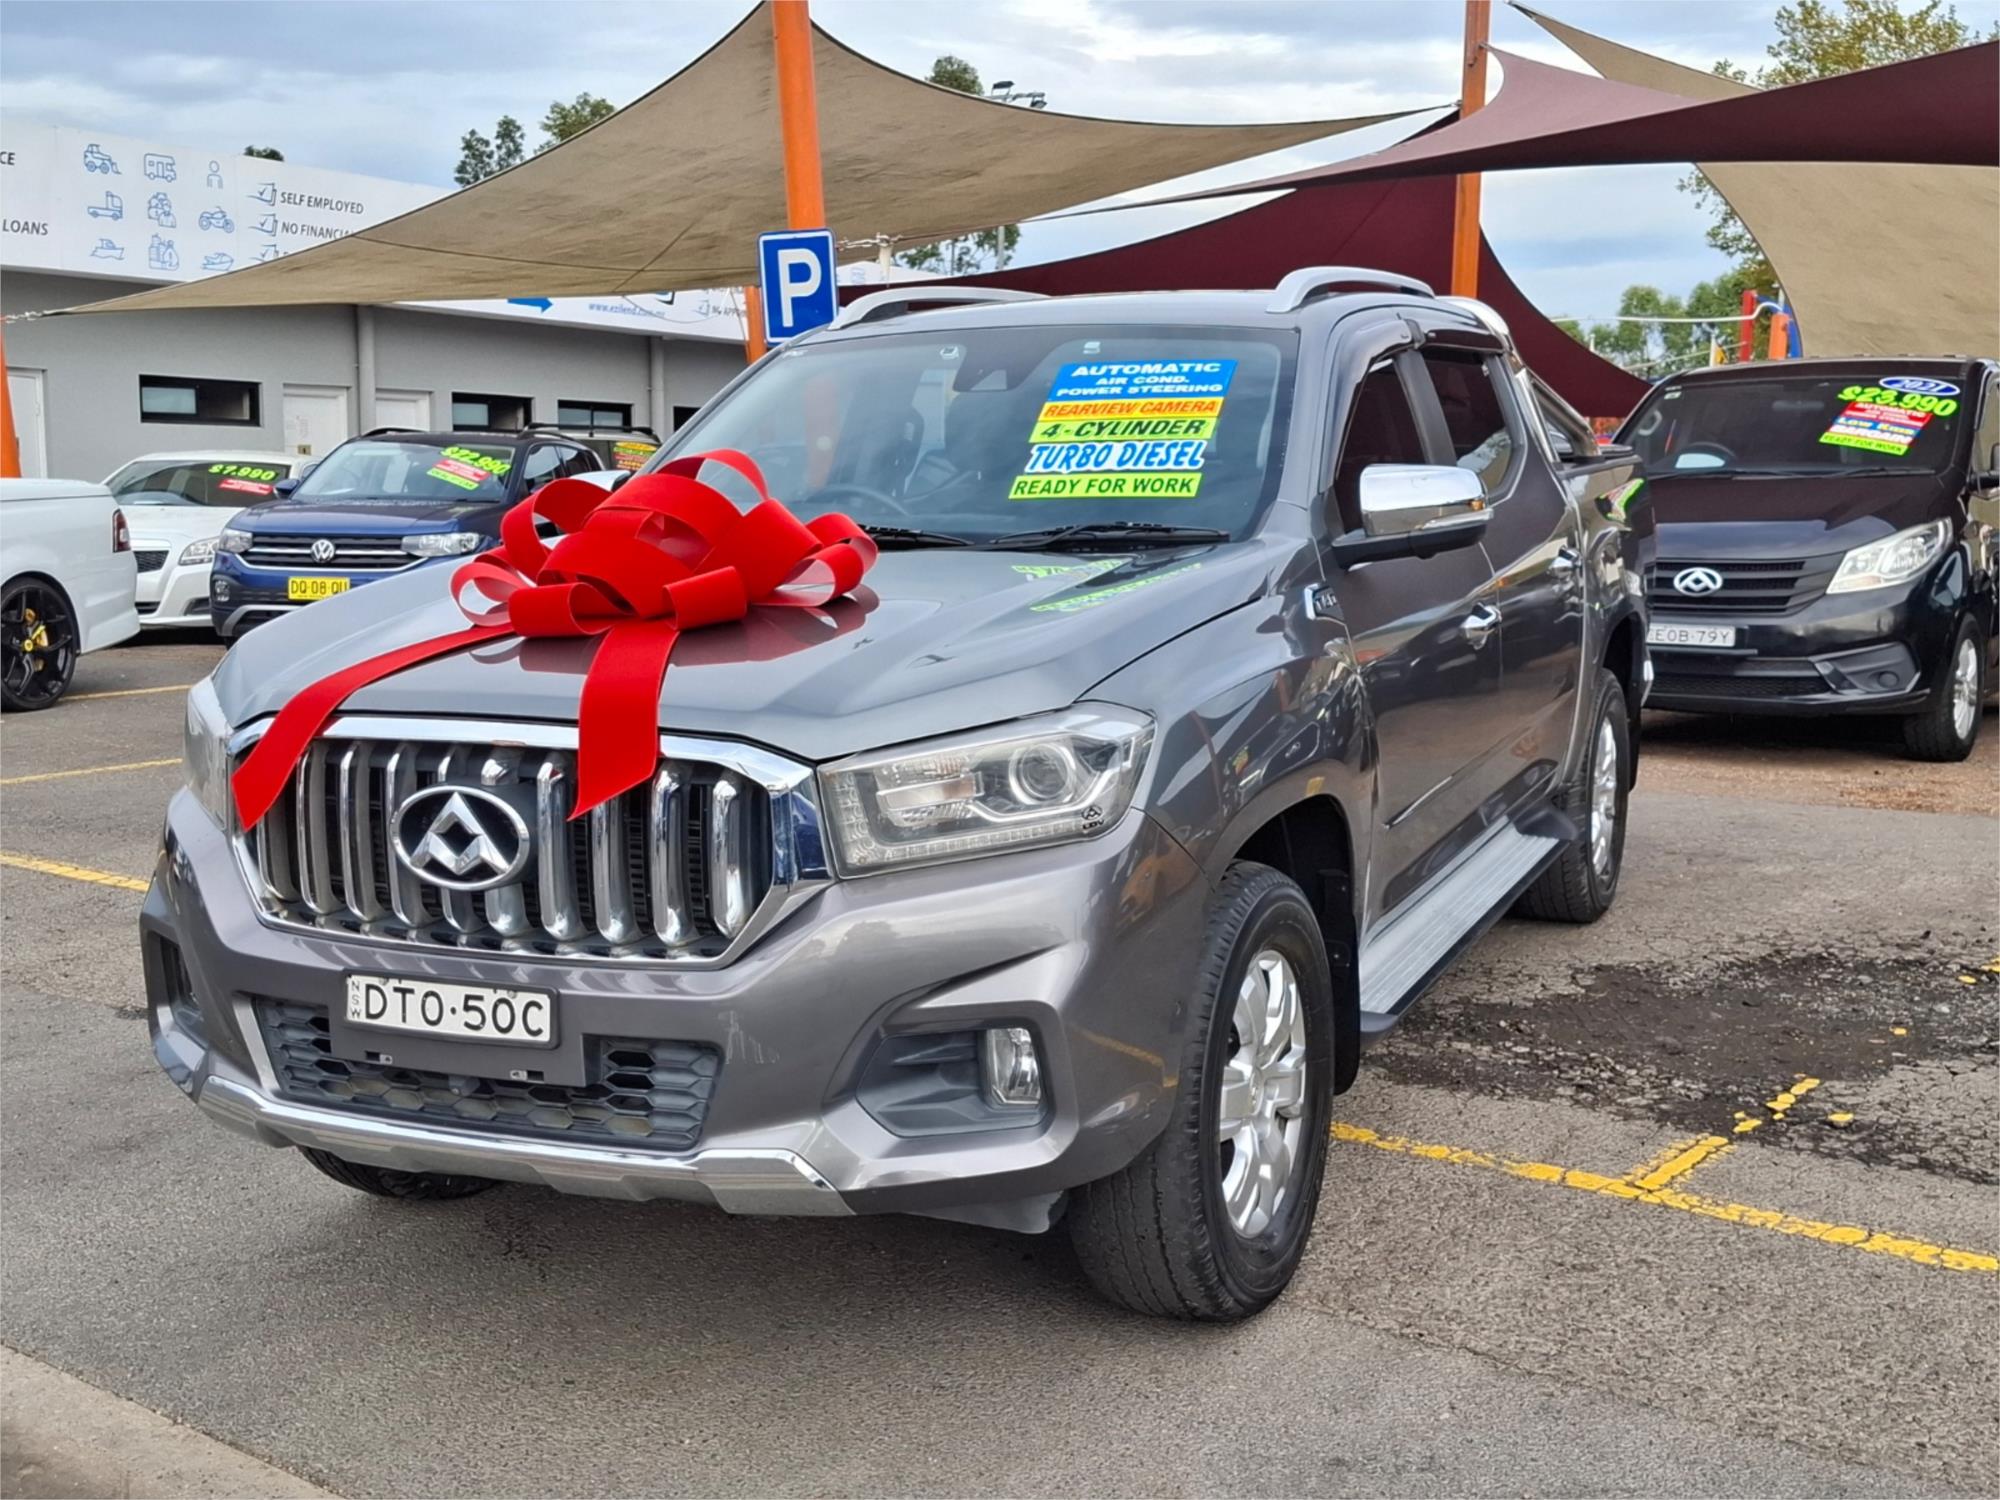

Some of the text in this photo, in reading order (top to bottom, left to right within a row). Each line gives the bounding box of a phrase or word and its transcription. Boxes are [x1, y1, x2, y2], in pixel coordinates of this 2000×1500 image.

[280, 191, 364, 214] SELF EMPLOYED
[2, 219, 48, 235] LOANS
[281, 221, 354, 240] NO FINANC
[778, 248, 822, 327] P
[1071, 362, 1222, 377] AUTOMATIC
[1096, 375, 1189, 386] AIR COND.
[1056, 384, 1223, 397] POWER STEERING
[1044, 400, 1217, 418] REARVIEW CAMERA
[1028, 440, 1206, 472] TURBO DIESEL
[1014, 477, 1195, 495] READY FOR WORK
